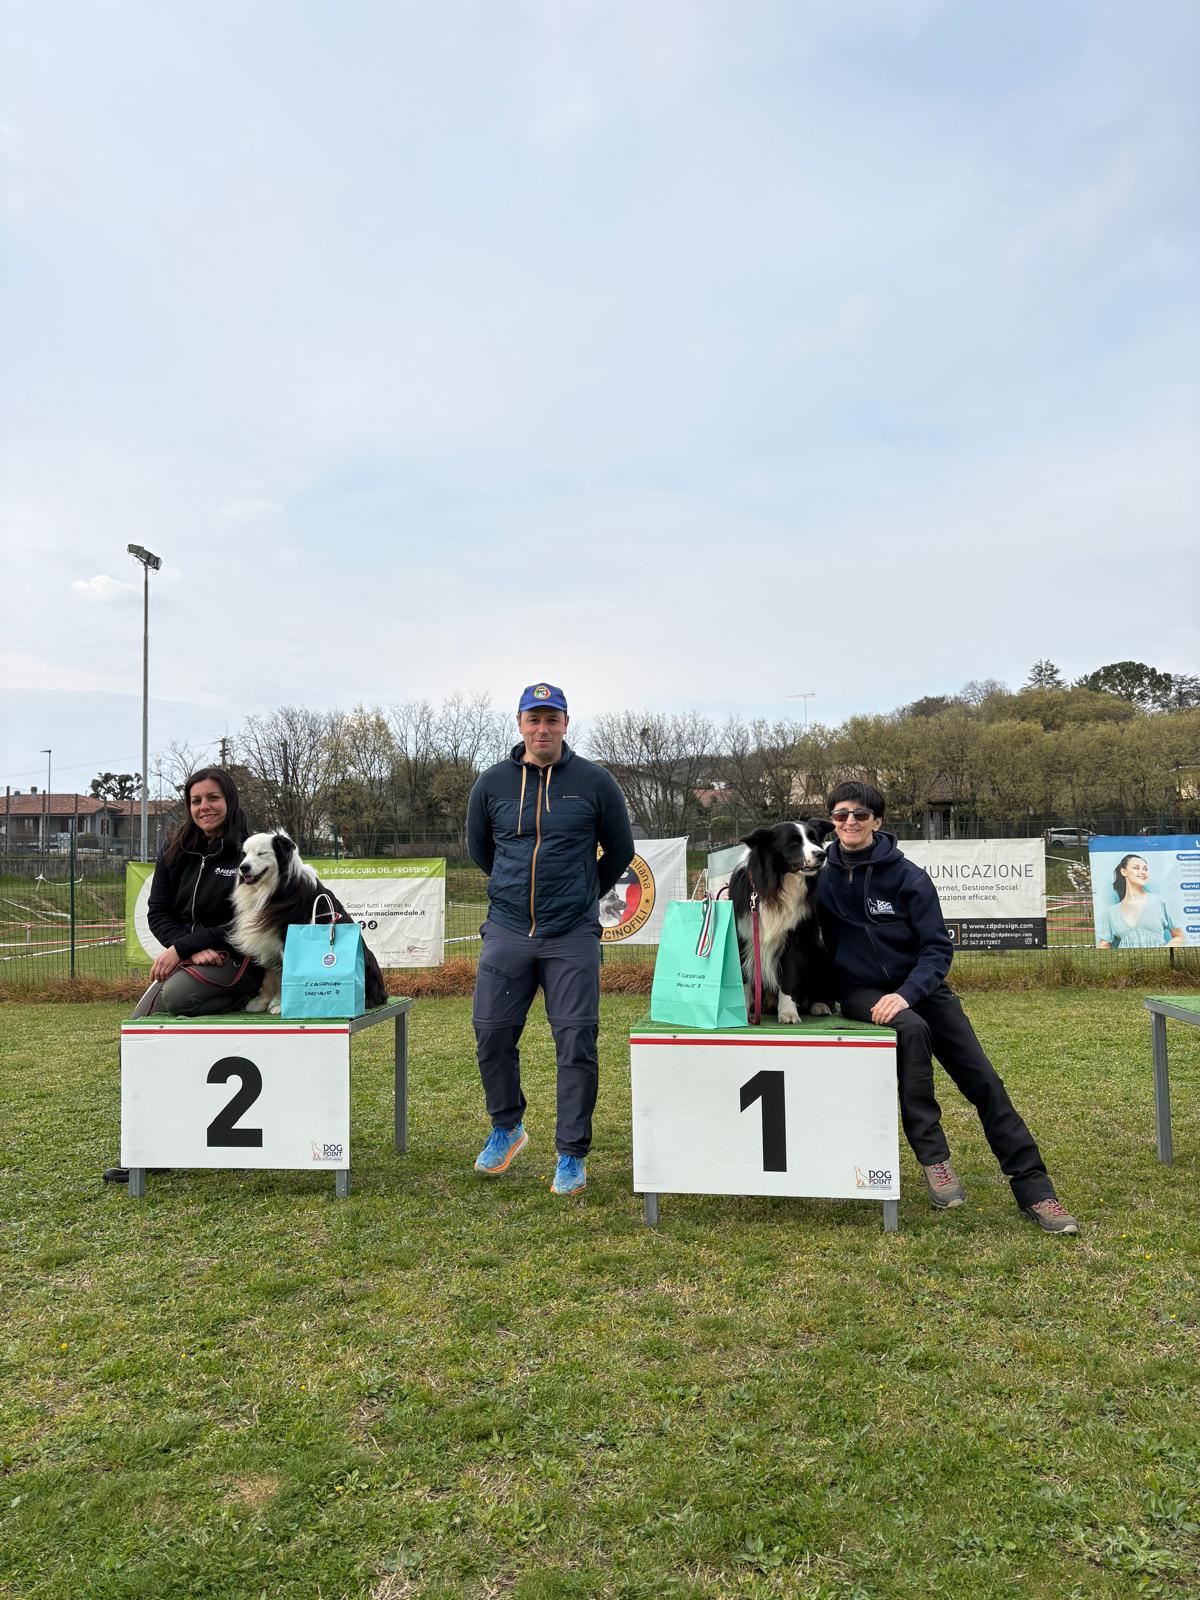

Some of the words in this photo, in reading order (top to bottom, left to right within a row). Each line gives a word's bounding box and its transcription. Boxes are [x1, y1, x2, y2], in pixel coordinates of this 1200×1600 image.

[331, 867, 355, 875] LEGGE
[378, 866, 392, 874] DEL
[604, 909, 648, 940] CINOFILI
[969, 922, 1034, 930] www.cdpdesign.com
[206, 1056, 263, 1147] 2
[739, 1070, 787, 1173] 1
[323, 1144, 343, 1152] DOG
[868, 1170, 892, 1179] DOG
